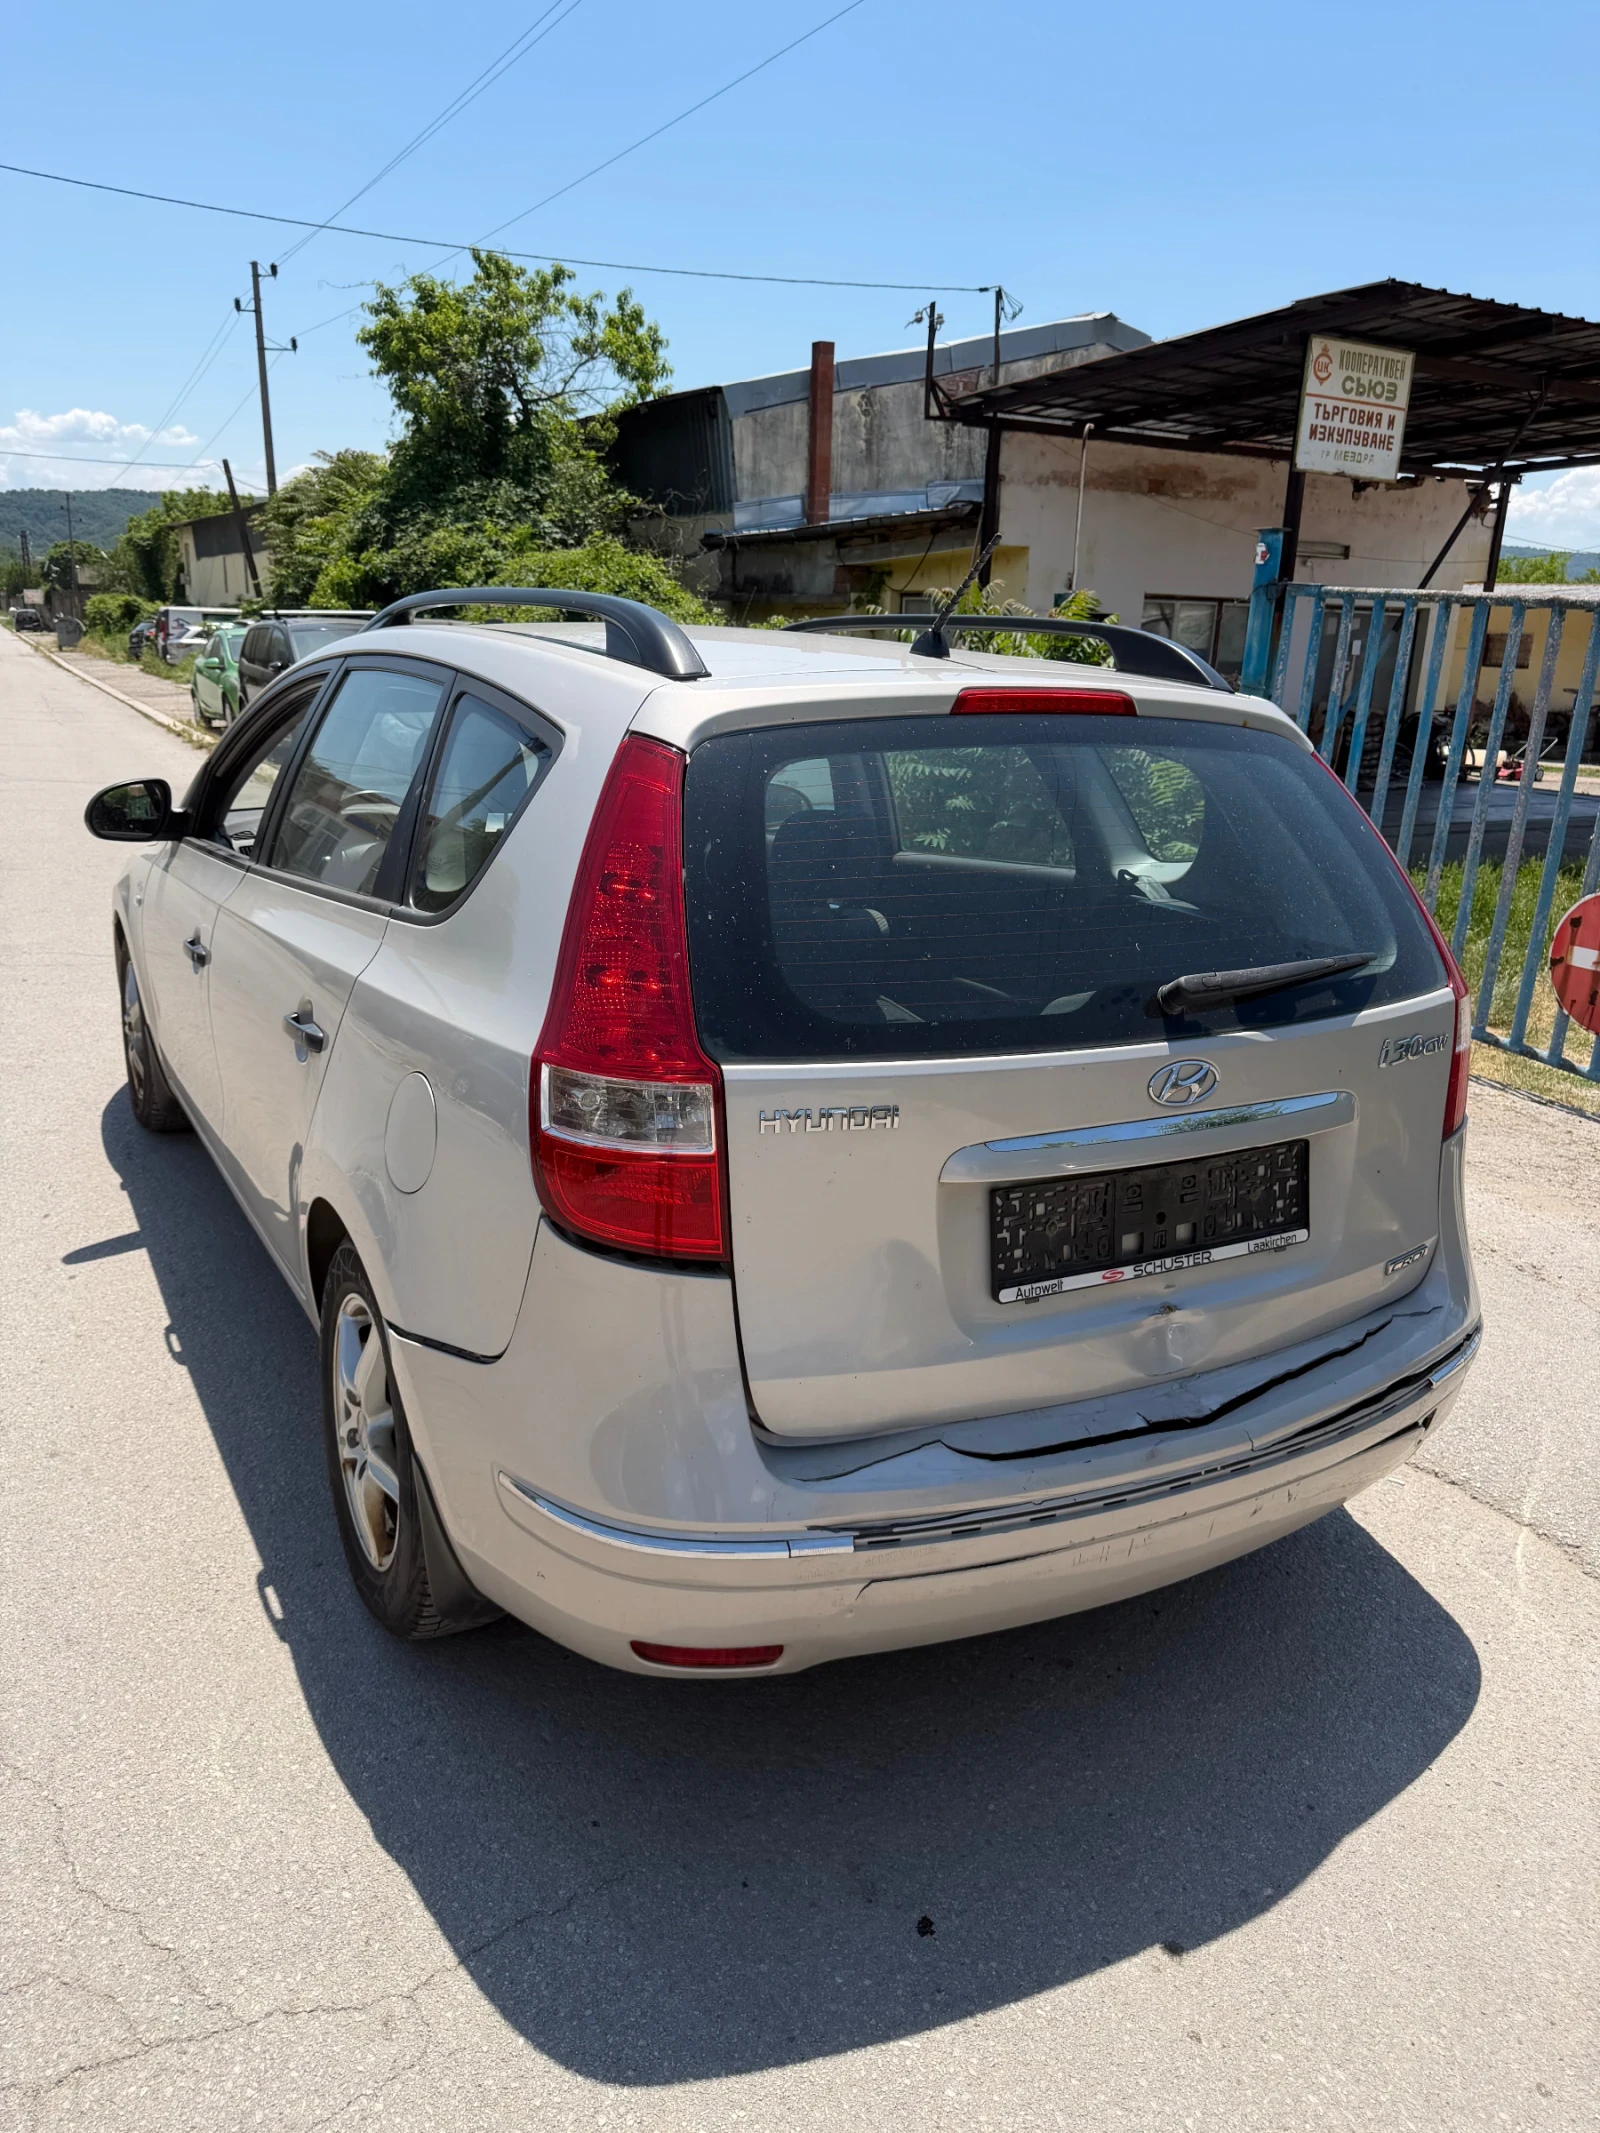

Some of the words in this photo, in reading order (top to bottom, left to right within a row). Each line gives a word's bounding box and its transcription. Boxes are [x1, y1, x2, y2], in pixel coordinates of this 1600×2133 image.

[1308, 423, 1395, 451] ИЗКУПУВАНЕ
[1387, 414, 1396, 431] И
[759, 1104, 900, 1134] HYUNDAI
[1015, 1279, 1064, 1300] Autowelt
[1247, 1232, 1297, 1253] Laakirchen
